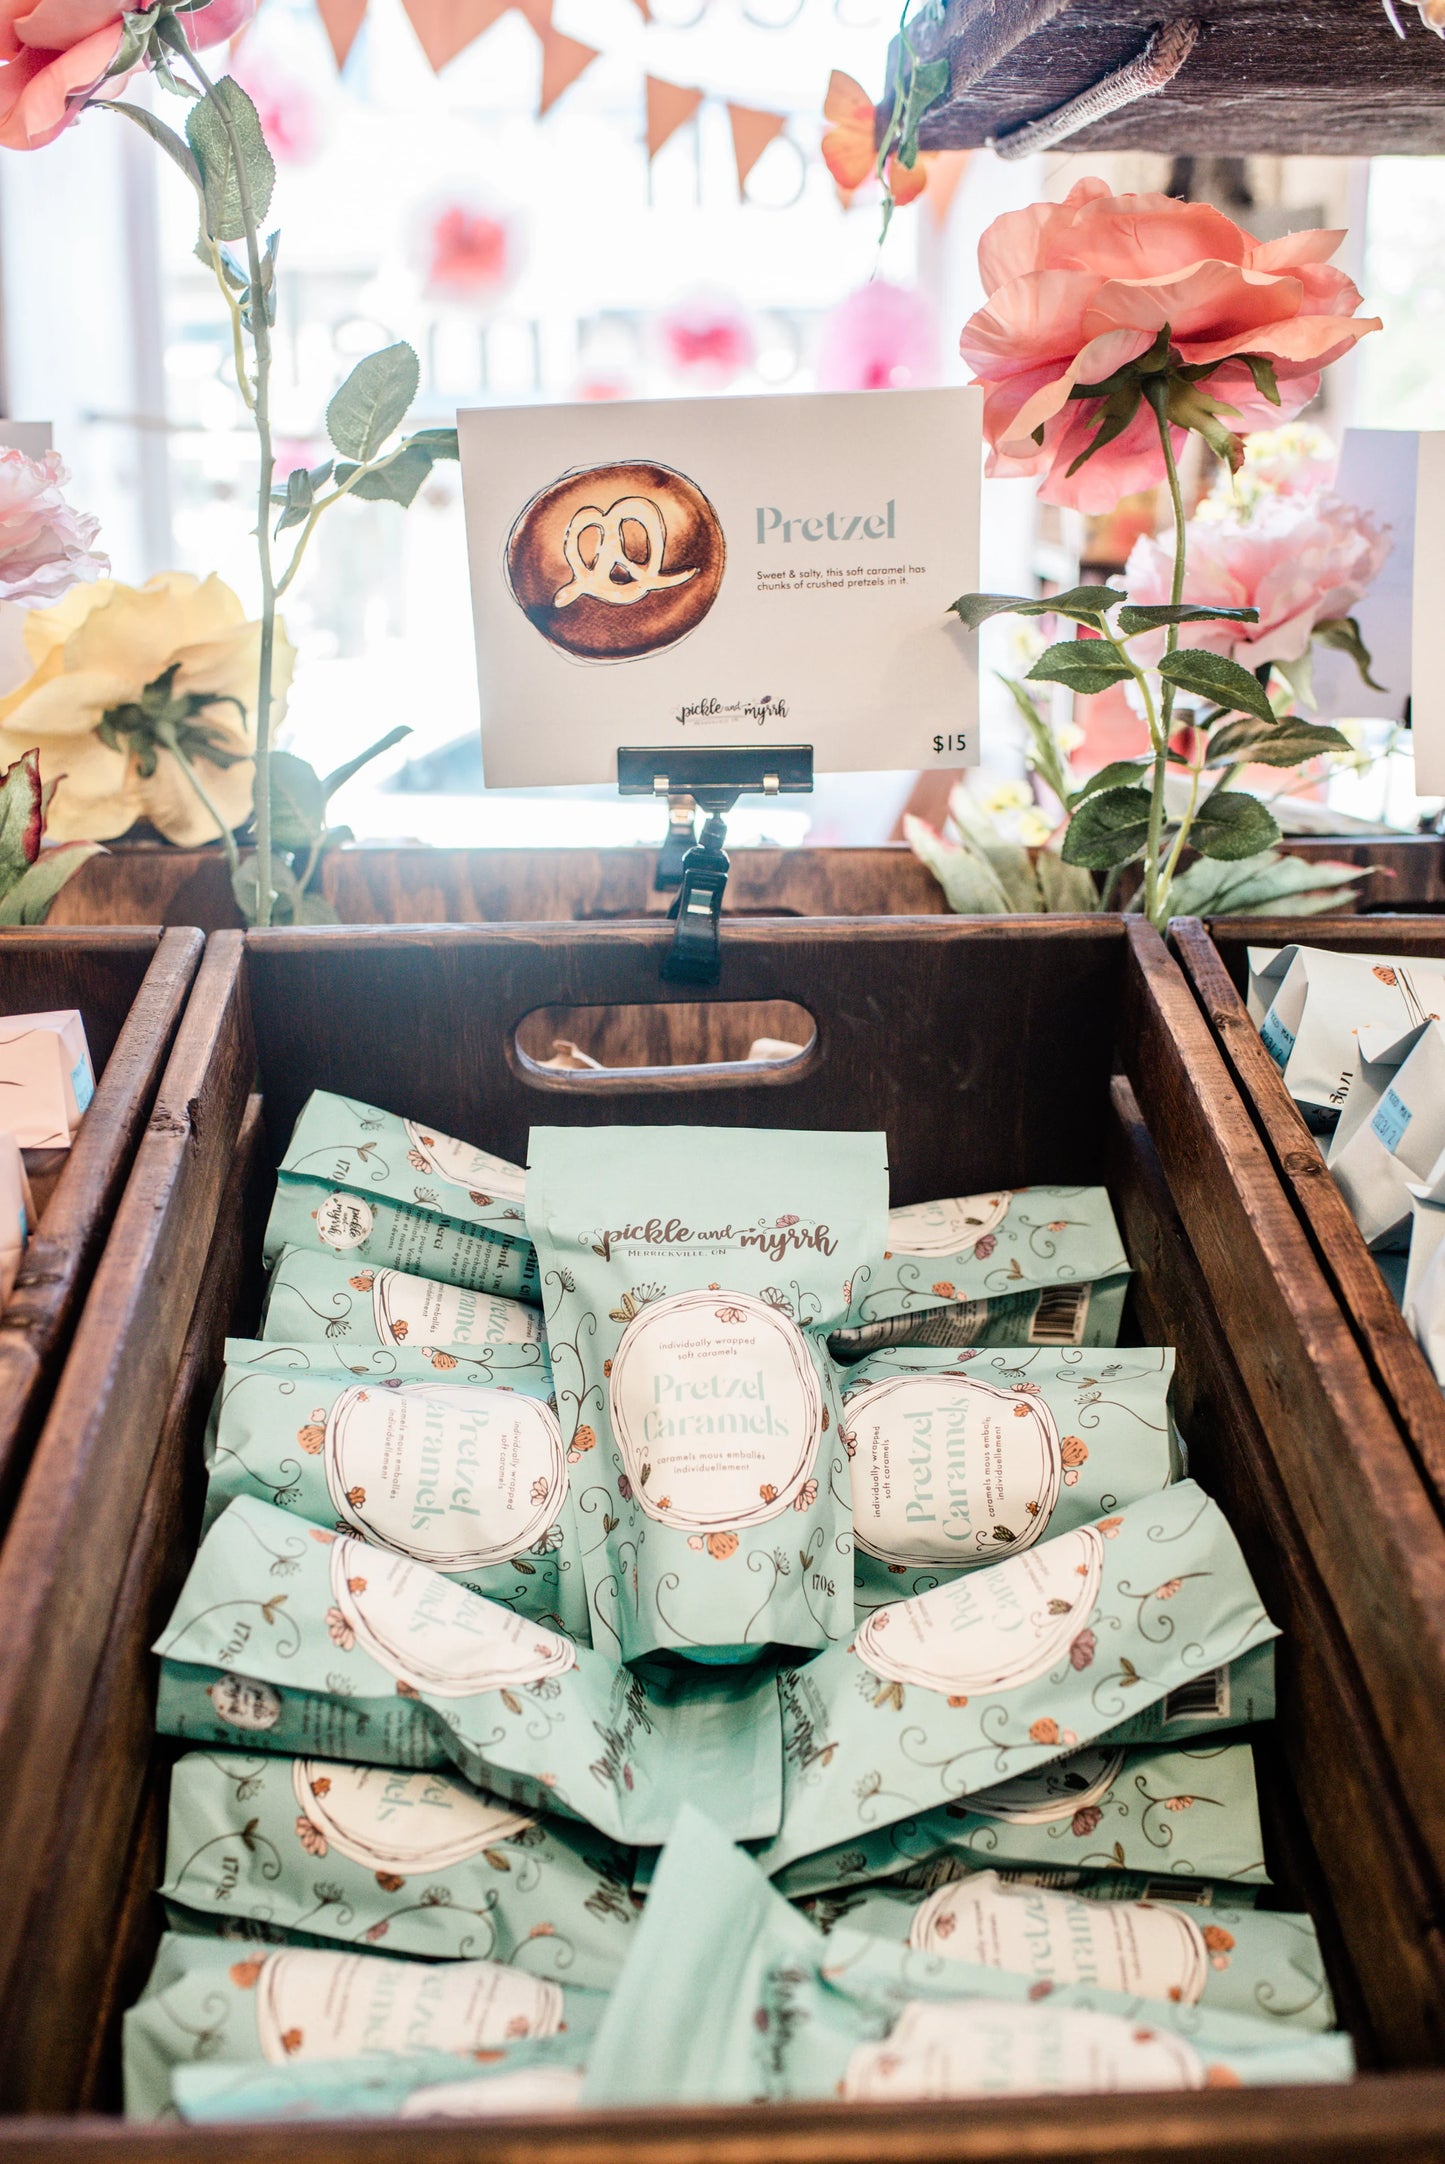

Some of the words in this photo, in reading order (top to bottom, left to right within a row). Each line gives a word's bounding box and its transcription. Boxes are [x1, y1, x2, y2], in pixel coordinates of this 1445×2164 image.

[755, 498, 896, 544] Pretzel
[756, 570, 786, 580] Sweet
[788, 569, 796, 579] &
[799, 568, 823, 579] salty,
[826, 567, 844, 577] this
[846, 566, 864, 576] soft
[866, 564, 906, 576] caramel
[908, 564, 926, 574] has
[756, 580, 791, 591] chunks
[794, 580, 804, 590] of
[806, 578, 844, 589] crushed
[847, 577, 884, 589] pretzels
[887, 576, 897, 586] in
[900, 576, 908, 585] it.
[681, 697, 724, 726] pickle
[724, 700, 743, 713] and
[744, 698, 790, 726] myrrh
[933, 734, 966, 753] $15
[326, 1159, 351, 1181] 170
[326, 1204, 343, 1237] myrrh
[347, 1206, 362, 1239] pickle
[423, 1212, 433, 1234] Merci
[433, 1215, 451, 1250] Merci
[398, 1233, 406, 1250] nous
[418, 1236, 426, 1254] pour
[465, 1239, 474, 1255] step
[604, 1218, 696, 1263] pickle
[697, 1224, 736, 1242] and
[740, 1224, 839, 1262] myrrh
[712, 1248, 726, 1256] ON
[460, 1257, 471, 1278] closer
[470, 1244, 482, 1278] purchase
[659, 1338, 712, 1350] individually
[715, 1336, 756, 1346] wrapped
[678, 1352, 694, 1360] soft
[697, 1348, 737, 1358] caramels
[654, 1370, 765, 1404] Pretzel
[644, 1405, 789, 1442] Caramels
[382, 1408, 395, 1480] individuellement
[512, 1420, 522, 1471] individually
[656, 1452, 696, 1465] caramels
[699, 1452, 724, 1460] mous
[872, 1426, 880, 1461] wrapped
[881, 1439, 890, 1479] caramels
[410, 1400, 446, 1531] aramels
[449, 1408, 490, 1516] Pretzel
[498, 1452, 506, 1490] caramels
[674, 1464, 750, 1475] individuellement
[902, 1411, 936, 1522] Pretzel
[936, 1397, 973, 1541] Caramels
[994, 1426, 1005, 1501] individuellement
[506, 1471, 517, 1511] wrapped
[870, 1464, 881, 1518] individually
[882, 1482, 891, 1499] soft
[982, 1478, 996, 1518] caramels
[812, 1574, 836, 1598] 170g
[218, 1621, 252, 1664] 170g
[215, 1856, 240, 1901] 170g
